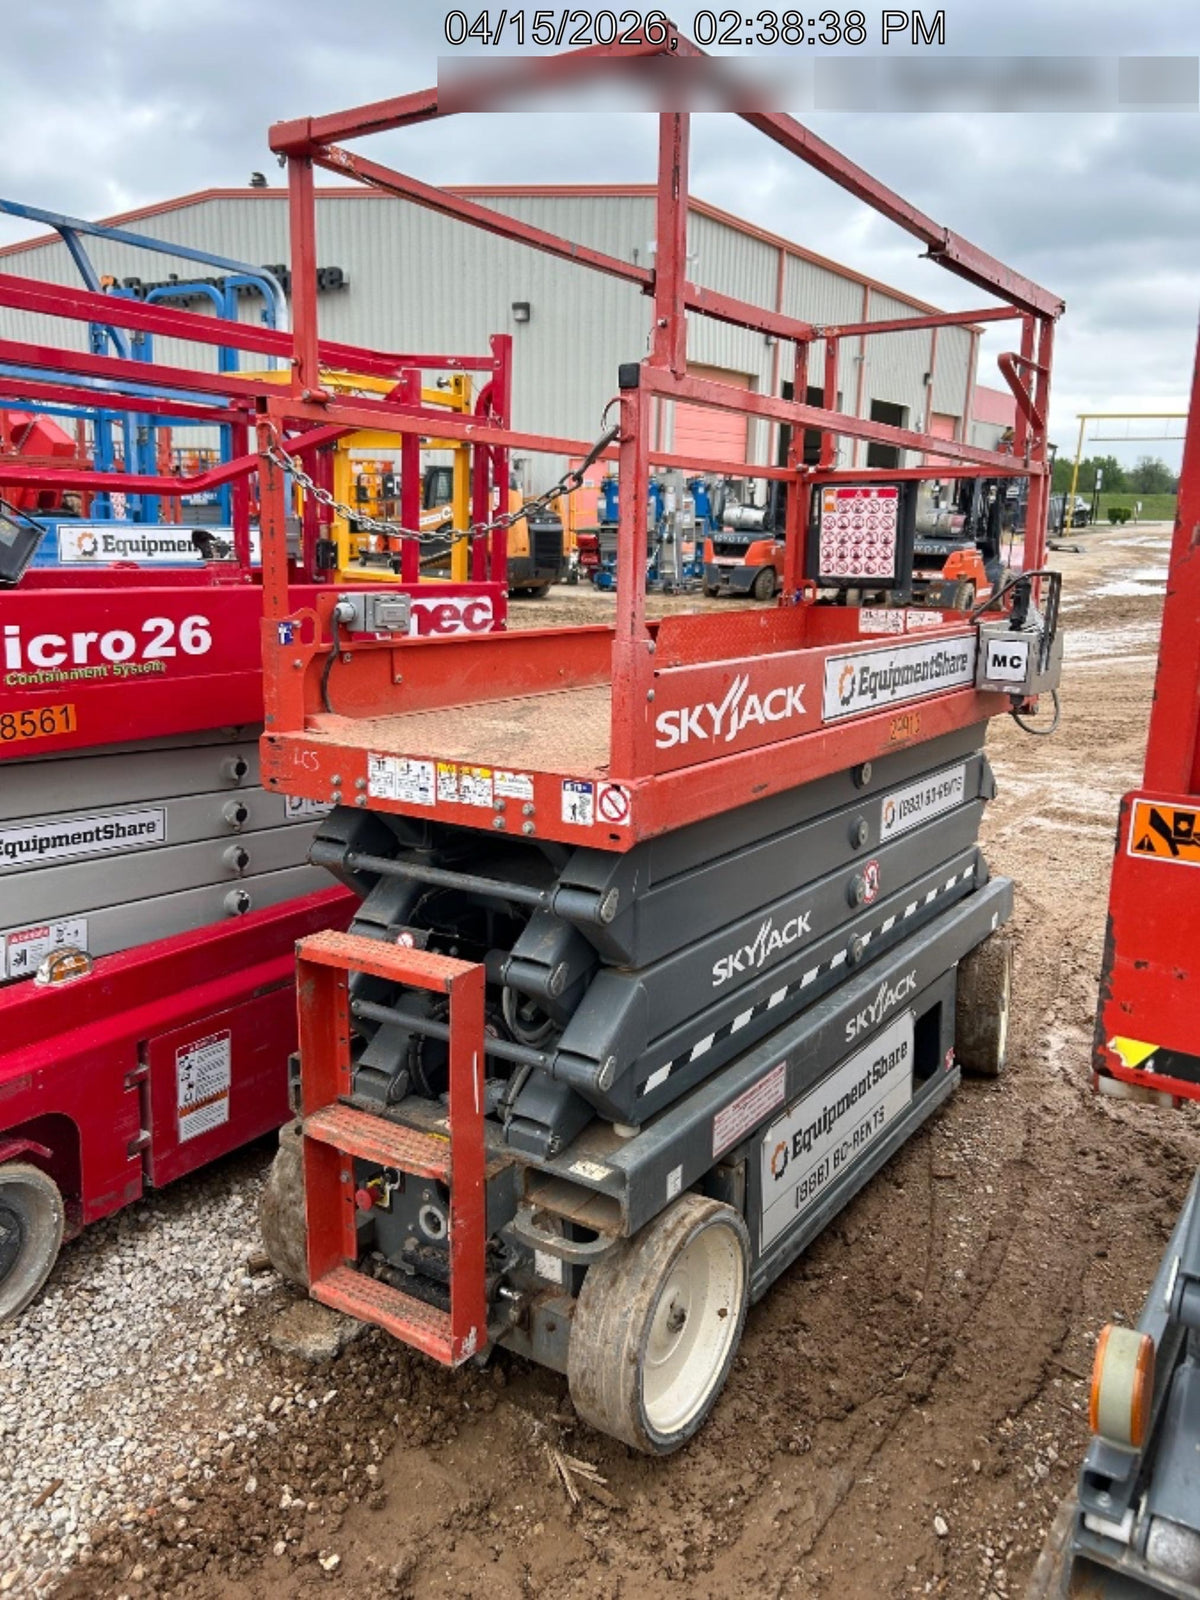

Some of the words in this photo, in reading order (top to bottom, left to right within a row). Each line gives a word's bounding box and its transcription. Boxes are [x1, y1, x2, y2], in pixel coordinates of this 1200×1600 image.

[857, 649, 968, 699] EquipmentShare
[991, 653, 1023, 669] MC
[655, 673, 807, 749] SKYJACK
[712, 910, 812, 987] SKYJACK
[844, 969, 917, 1043] SKYJACK
[791, 1040, 908, 1161] EquipmentShare
